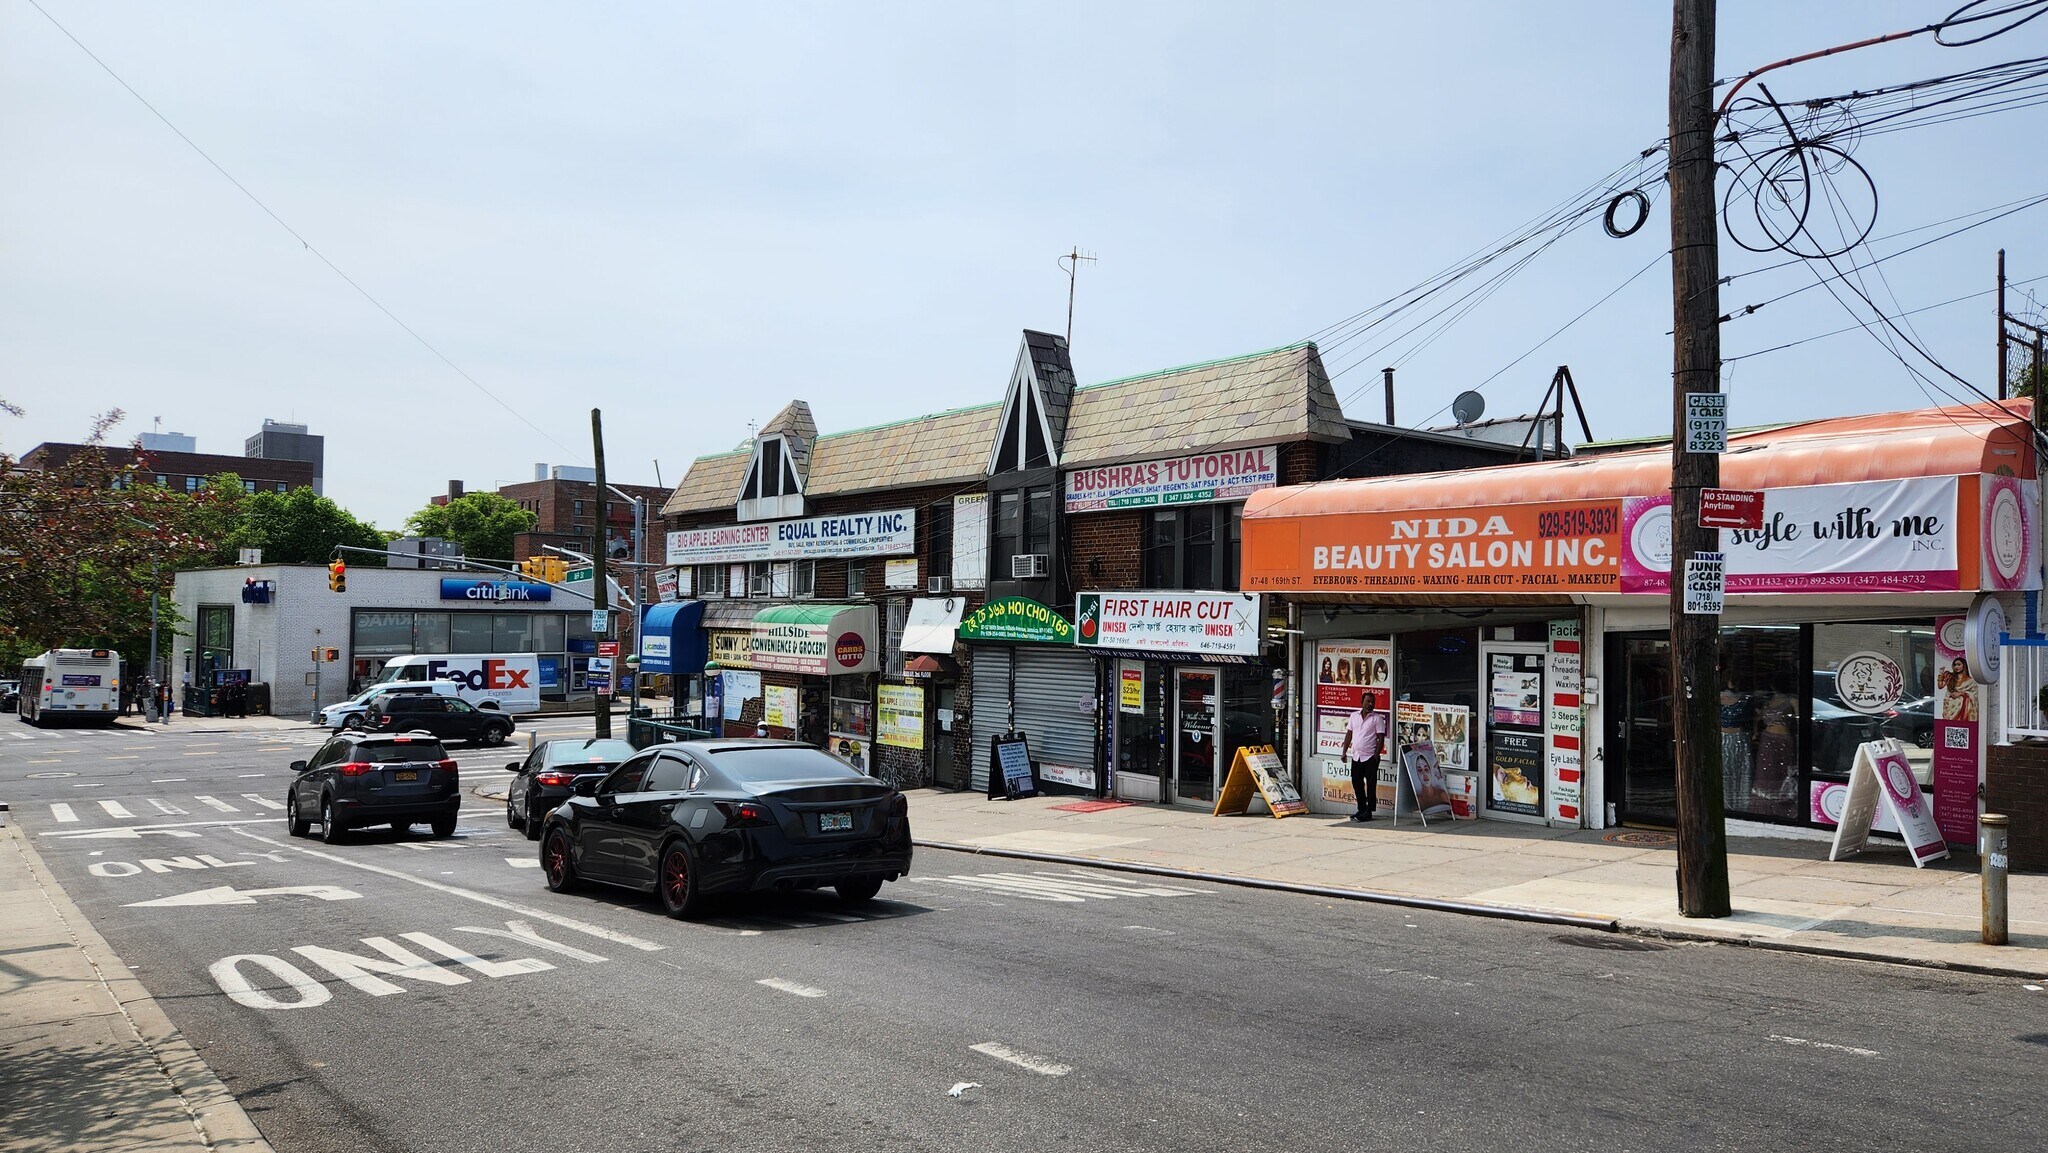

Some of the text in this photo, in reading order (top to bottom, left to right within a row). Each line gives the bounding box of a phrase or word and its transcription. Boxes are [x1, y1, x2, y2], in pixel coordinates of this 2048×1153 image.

[1691, 408, 1724, 417] 4 CARS
[1689, 420, 1725, 430] (917)
[1694, 432, 1720, 441] 436
[1690, 441, 1725, 450] 8323
[1074, 449, 1270, 492] BUSHRA'S TUTORIAL
[1228, 477, 1239, 485] ACT
[1241, 475, 1257, 483] TEST
[958, 496, 988, 505] GREEN
[1704, 492, 1754, 502] NO STANDING
[1704, 501, 1735, 511] Anytime
[778, 513, 907, 541] EQUAL REALTY INC.
[1391, 515, 1513, 539] NIDA
[1538, 507, 1618, 538] 929-519-3931
[1814, 507, 1881, 540] with
[1892, 515, 1944, 537] me
[677, 525, 770, 548] BIG APPLE LEARNING CENTER
[1911, 539, 1944, 551] INC.
[1314, 538, 1618, 570] BEAUTY SALON INC.
[1689, 562, 1722, 571] JUNK
[1250, 577, 1269, 585] 87-48
[1271, 576, 1290, 585] 169th
[1313, 573, 1617, 585] EYEBROWS THREADING WAXING HAIR CUT FACIAL MAKEUP
[1699, 572, 1721, 581] CAR
[1739, 577, 1754, 586] NY
[1785, 576, 1808, 588] (917)
[1810, 576, 1850, 585] 892-8591
[1854, 575, 1879, 587] (347)
[1881, 574, 1926, 585] 484-8732
[466, 584, 529, 600] citibank
[1696, 592, 1713, 601] (718)
[1079, 598, 1099, 623] Desi
[1103, 599, 1233, 620] FIRST HAIR CUT
[1688, 601, 1721, 611] 801-6395
[1008, 601, 1069, 636] HOI CHOI 169
[768, 627, 810, 639] HILLSIDE
[1102, 622, 1126, 633] UNISEX
[1205, 623, 1233, 636] UNISEX
[1550, 624, 1579, 636] Facia
[716, 636, 738, 651] SUNNY
[752, 638, 826, 656] CONVENIENCE & GROCERY
[1200, 641, 1236, 650] 646-719-4591
[1113, 650, 1140, 658] FIRST
[1143, 652, 1170, 660] HAIR
[1200, 654, 1247, 664] UNISEX
[429, 659, 530, 691] FedEx
[1555, 680, 1579, 690] Waxing
[1398, 704, 1424, 712] FREE
[1552, 711, 1578, 722] 3 Steps
[1183, 720, 1211, 730] Welcome
[1550, 722, 1568, 732] Layer
[1504, 736, 1528, 747] FREE
[1514, 757, 1536, 766] FACIAL
[1550, 753, 1580, 766] Eye Lashe
[1324, 788, 1336, 798] Full
[87, 848, 291, 877] ONLY
[208, 918, 609, 1011] ONLY
